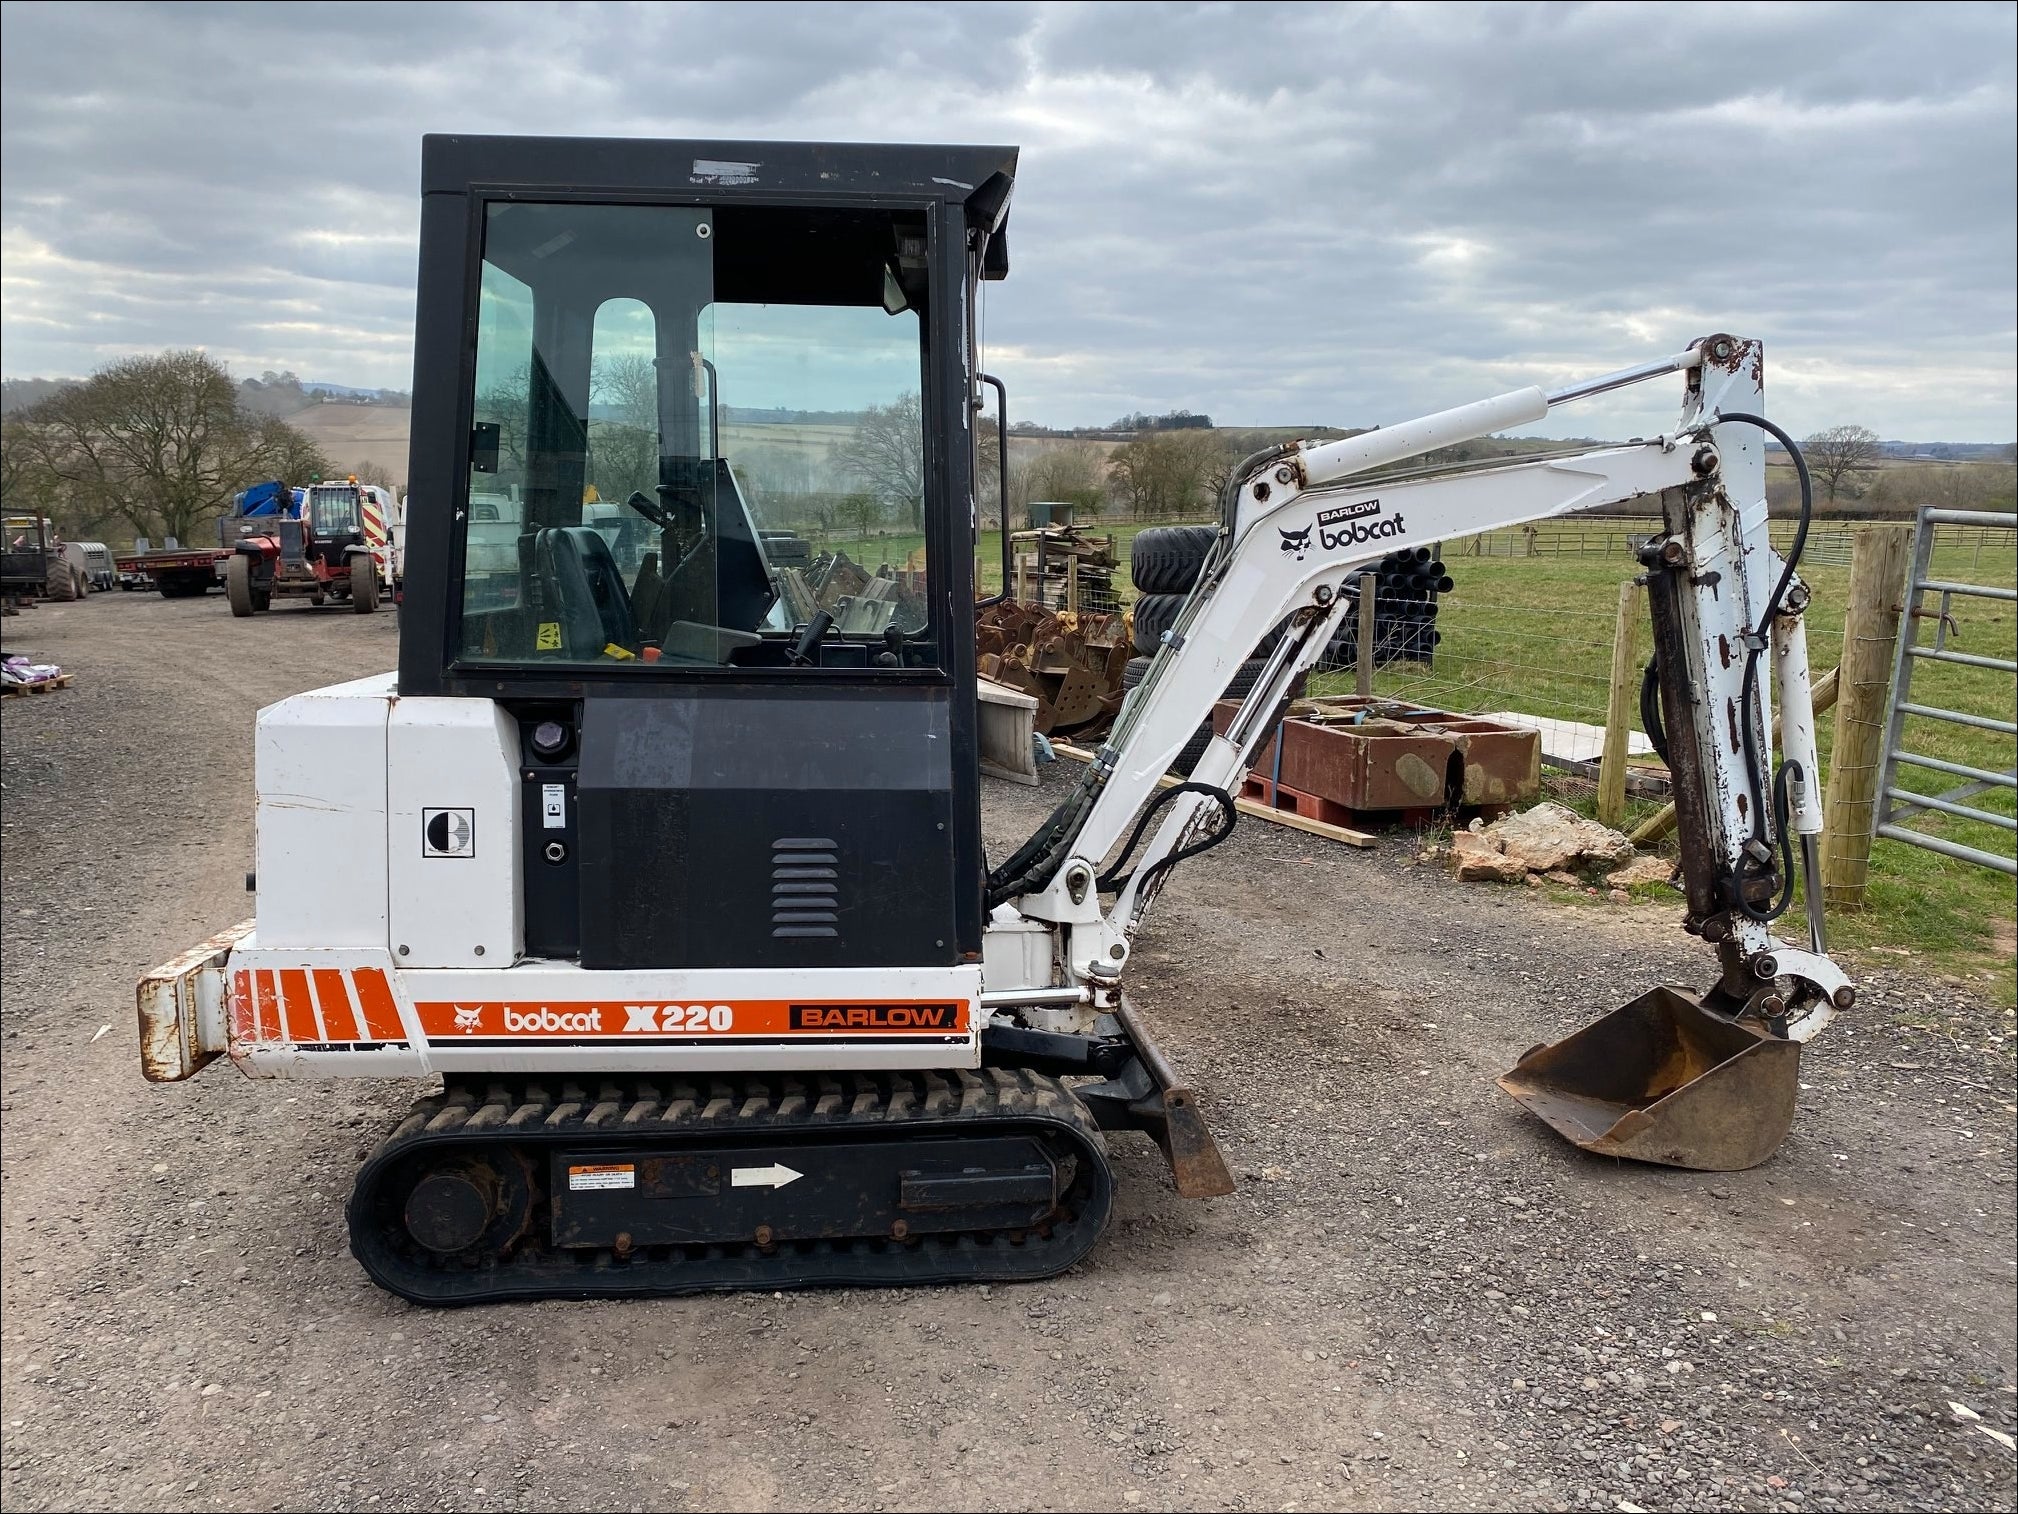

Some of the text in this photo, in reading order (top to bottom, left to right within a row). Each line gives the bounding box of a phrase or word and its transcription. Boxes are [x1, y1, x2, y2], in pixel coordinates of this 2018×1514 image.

[1320, 501, 1378, 521] BARLOW
[1319, 512, 1406, 550] bobcat
[504, 1005, 944, 1031] bobcat X220 BARLOW
